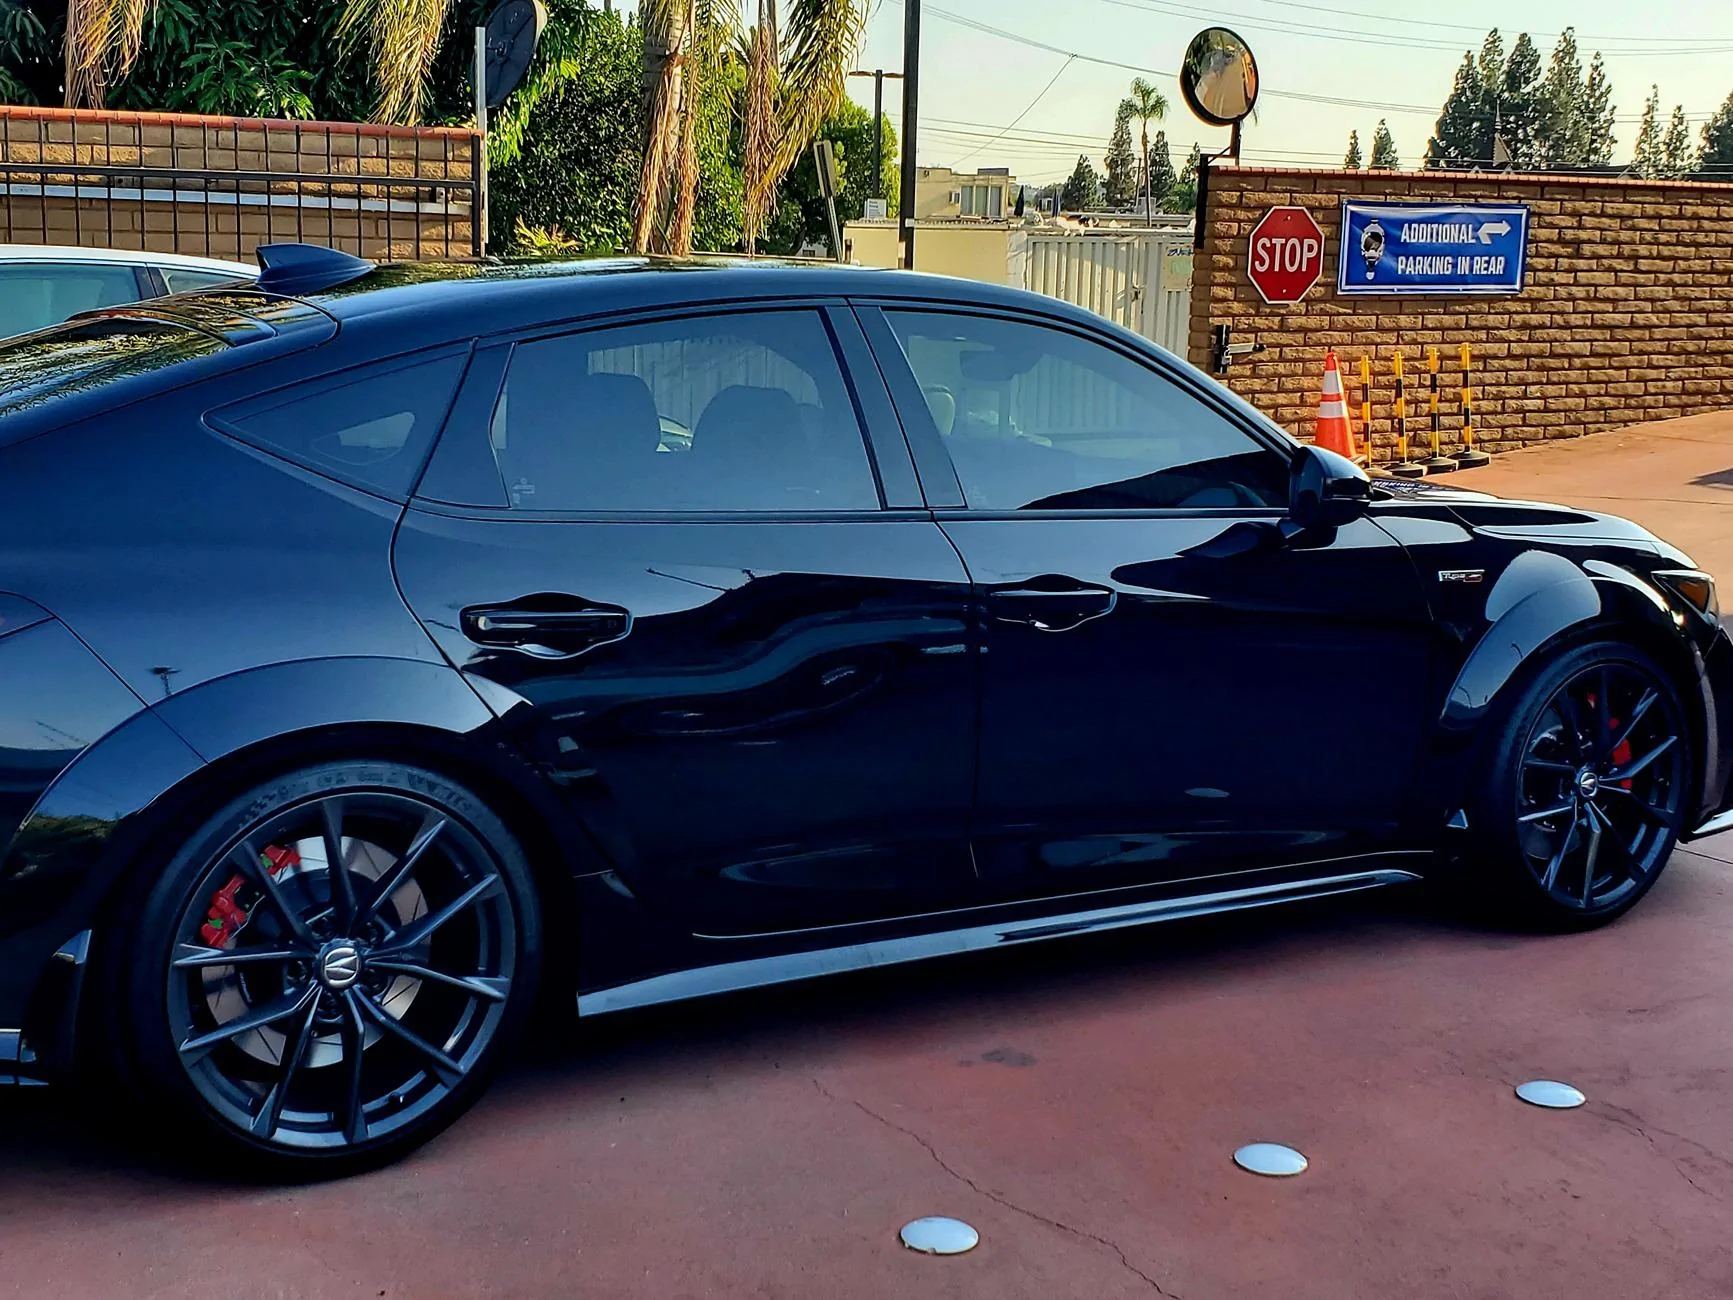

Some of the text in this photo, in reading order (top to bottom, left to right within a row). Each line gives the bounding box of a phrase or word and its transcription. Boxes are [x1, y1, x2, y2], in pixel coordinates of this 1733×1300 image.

[1400, 223, 1476, 244] ADDITIONAL
[1254, 237, 1319, 272] STOP
[1397, 256, 1505, 275] PARKING IN REAR
